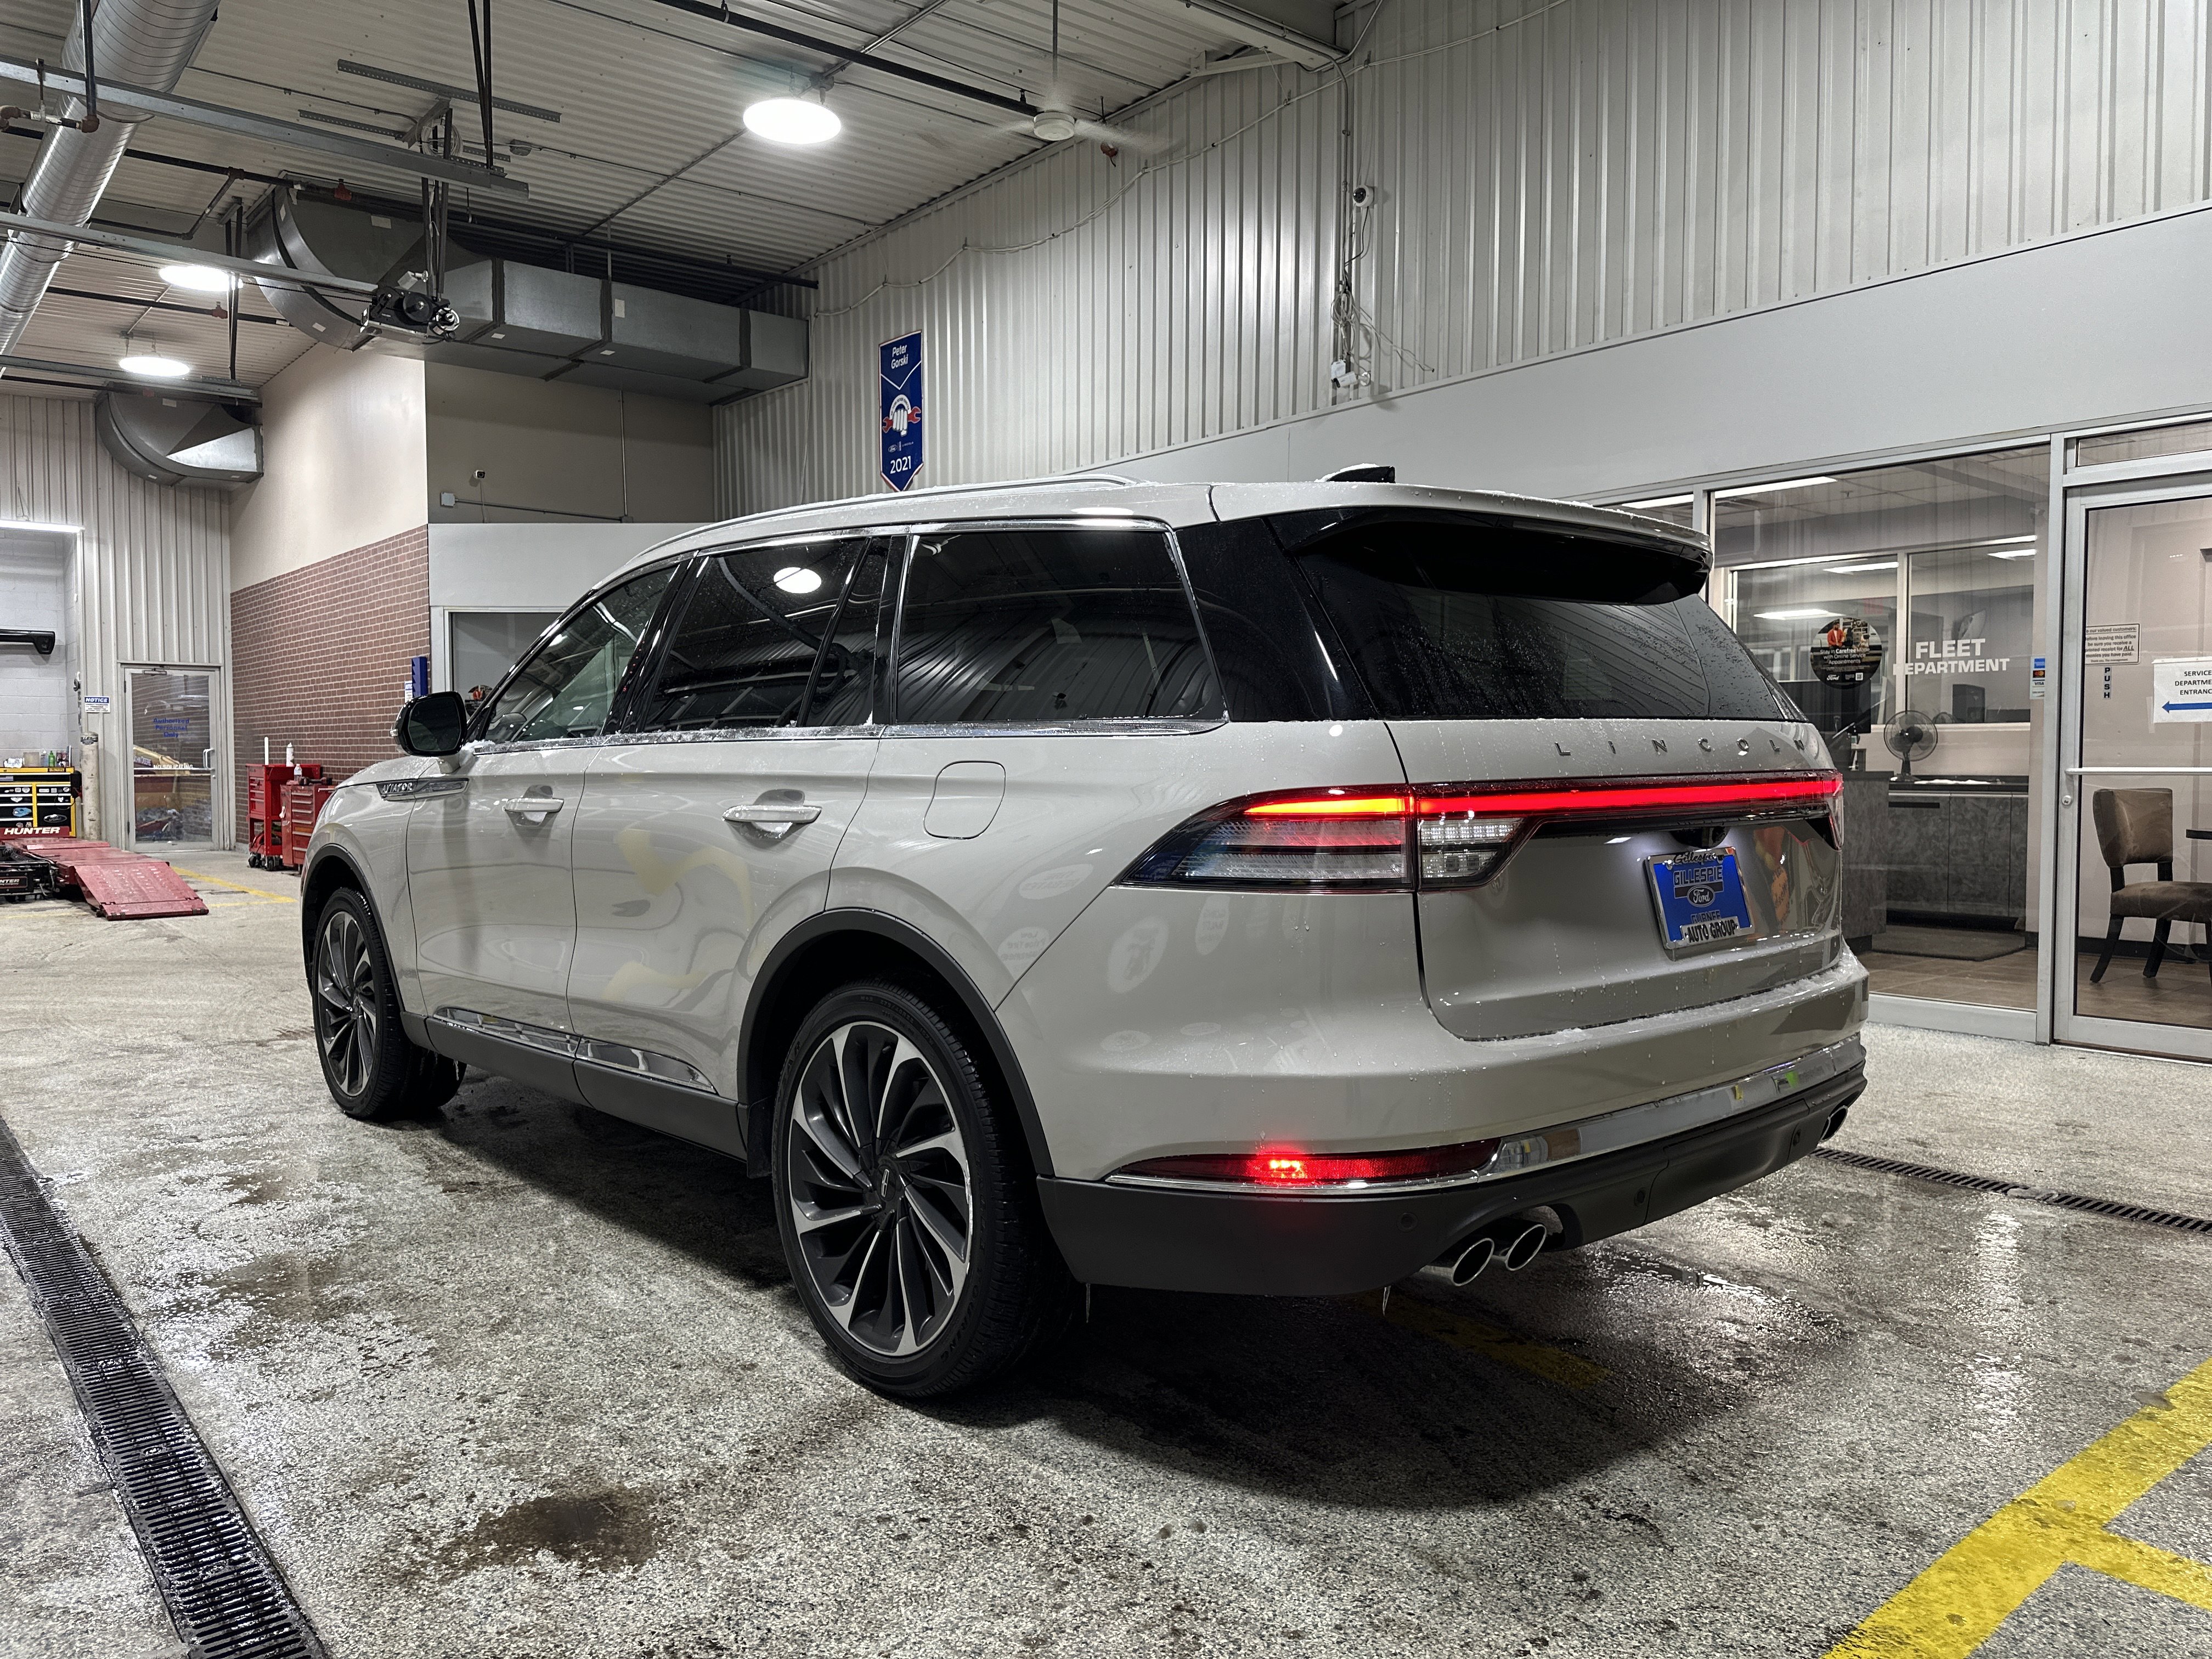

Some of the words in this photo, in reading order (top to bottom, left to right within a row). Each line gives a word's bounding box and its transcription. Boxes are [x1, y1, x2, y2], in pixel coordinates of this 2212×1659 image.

[892, 345, 907, 357] Peter
[891, 354, 909, 369] Gorski
[890, 456, 911, 474] 2021
[1915, 638, 1985, 659] FLEET
[1554, 737, 1806, 757] LINCOLN
[381, 782, 413, 793] AVIATOR
[4, 827, 60, 835] HUNTER
[1673, 851, 1718, 865] Gillespie
[1674, 865, 1723, 885] GILLESPIE
[1693, 889, 1711, 904] Ford
[1687, 923, 1709, 943] AUTO
[1709, 919, 1736, 939] GROUP
